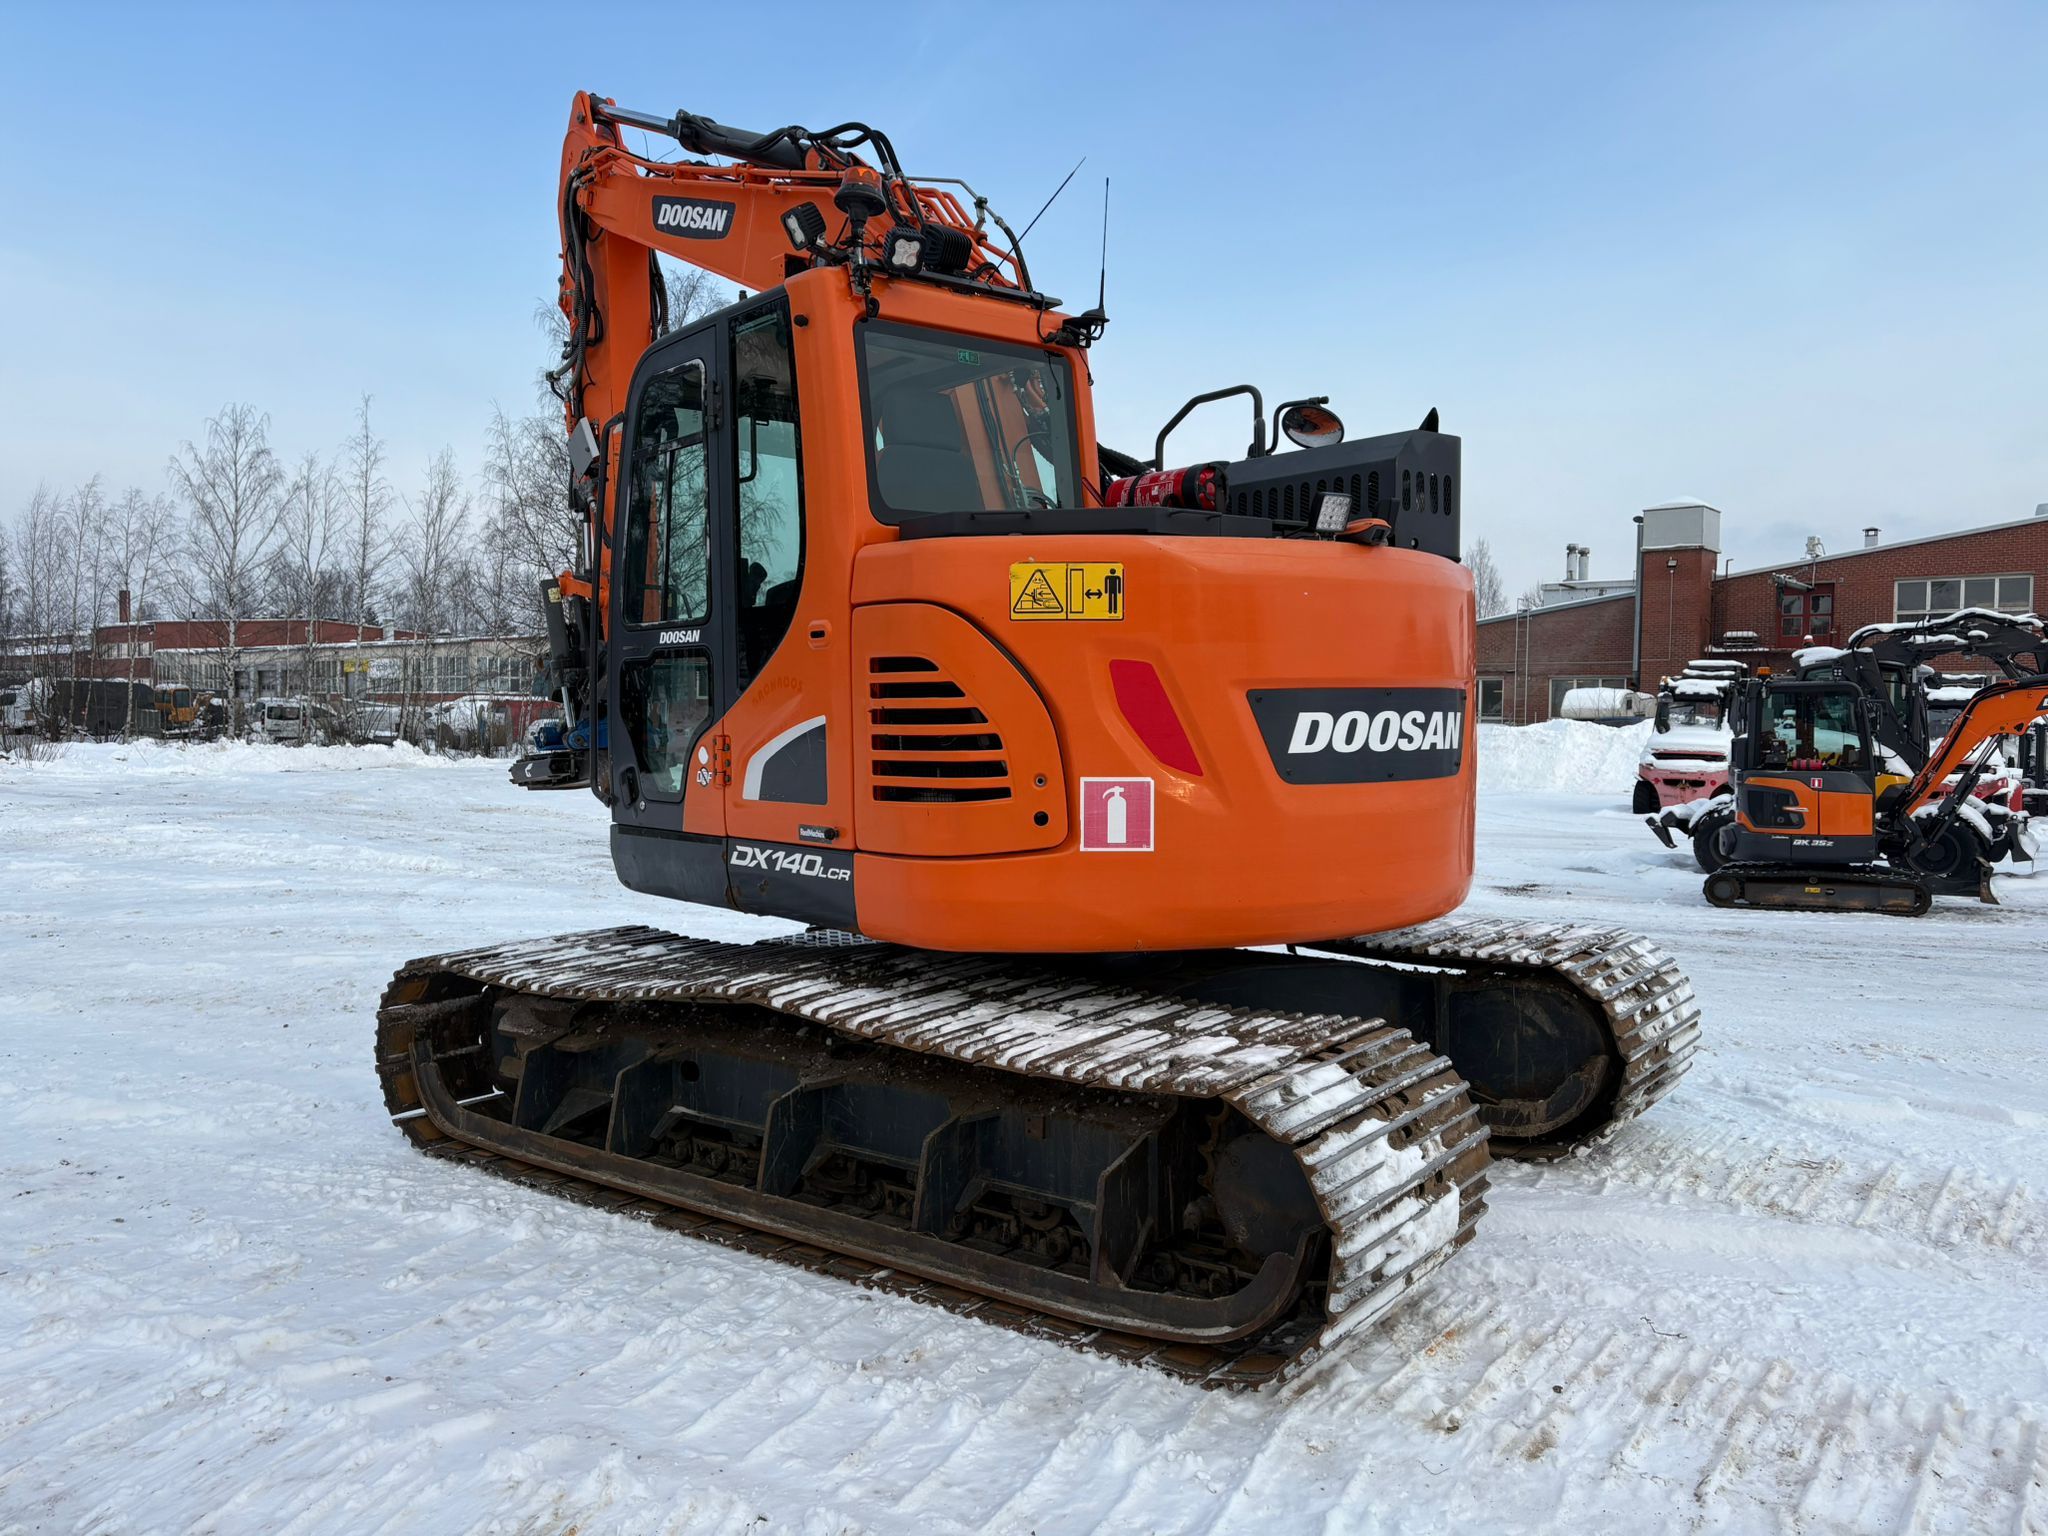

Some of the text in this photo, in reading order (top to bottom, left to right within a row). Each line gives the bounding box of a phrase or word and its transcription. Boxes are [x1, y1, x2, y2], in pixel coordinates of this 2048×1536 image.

[657, 203, 728, 232] DOOSAN
[659, 629, 701, 644] DOOSAN
[1287, 710, 1462, 754] DOOSAN
